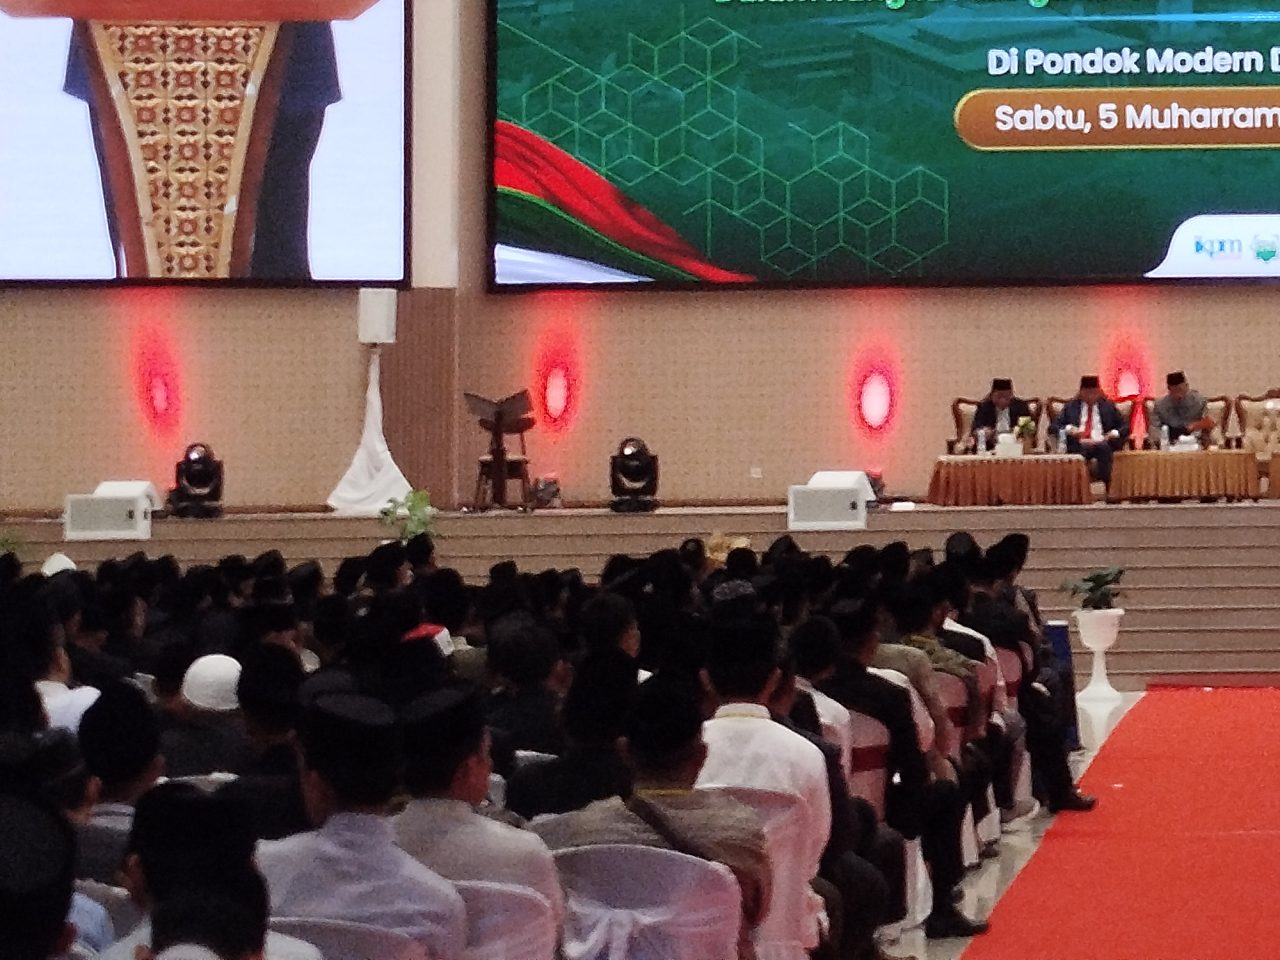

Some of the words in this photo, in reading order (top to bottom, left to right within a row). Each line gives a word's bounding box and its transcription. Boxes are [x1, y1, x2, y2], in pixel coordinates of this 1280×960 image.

[987, 47, 1019, 75] Di
[1025, 47, 1141, 75] Pondok
[1146, 45, 1264, 74] Modern
[995, 103, 1092, 134] Sabtu,
[1098, 102, 1119, 130] 5
